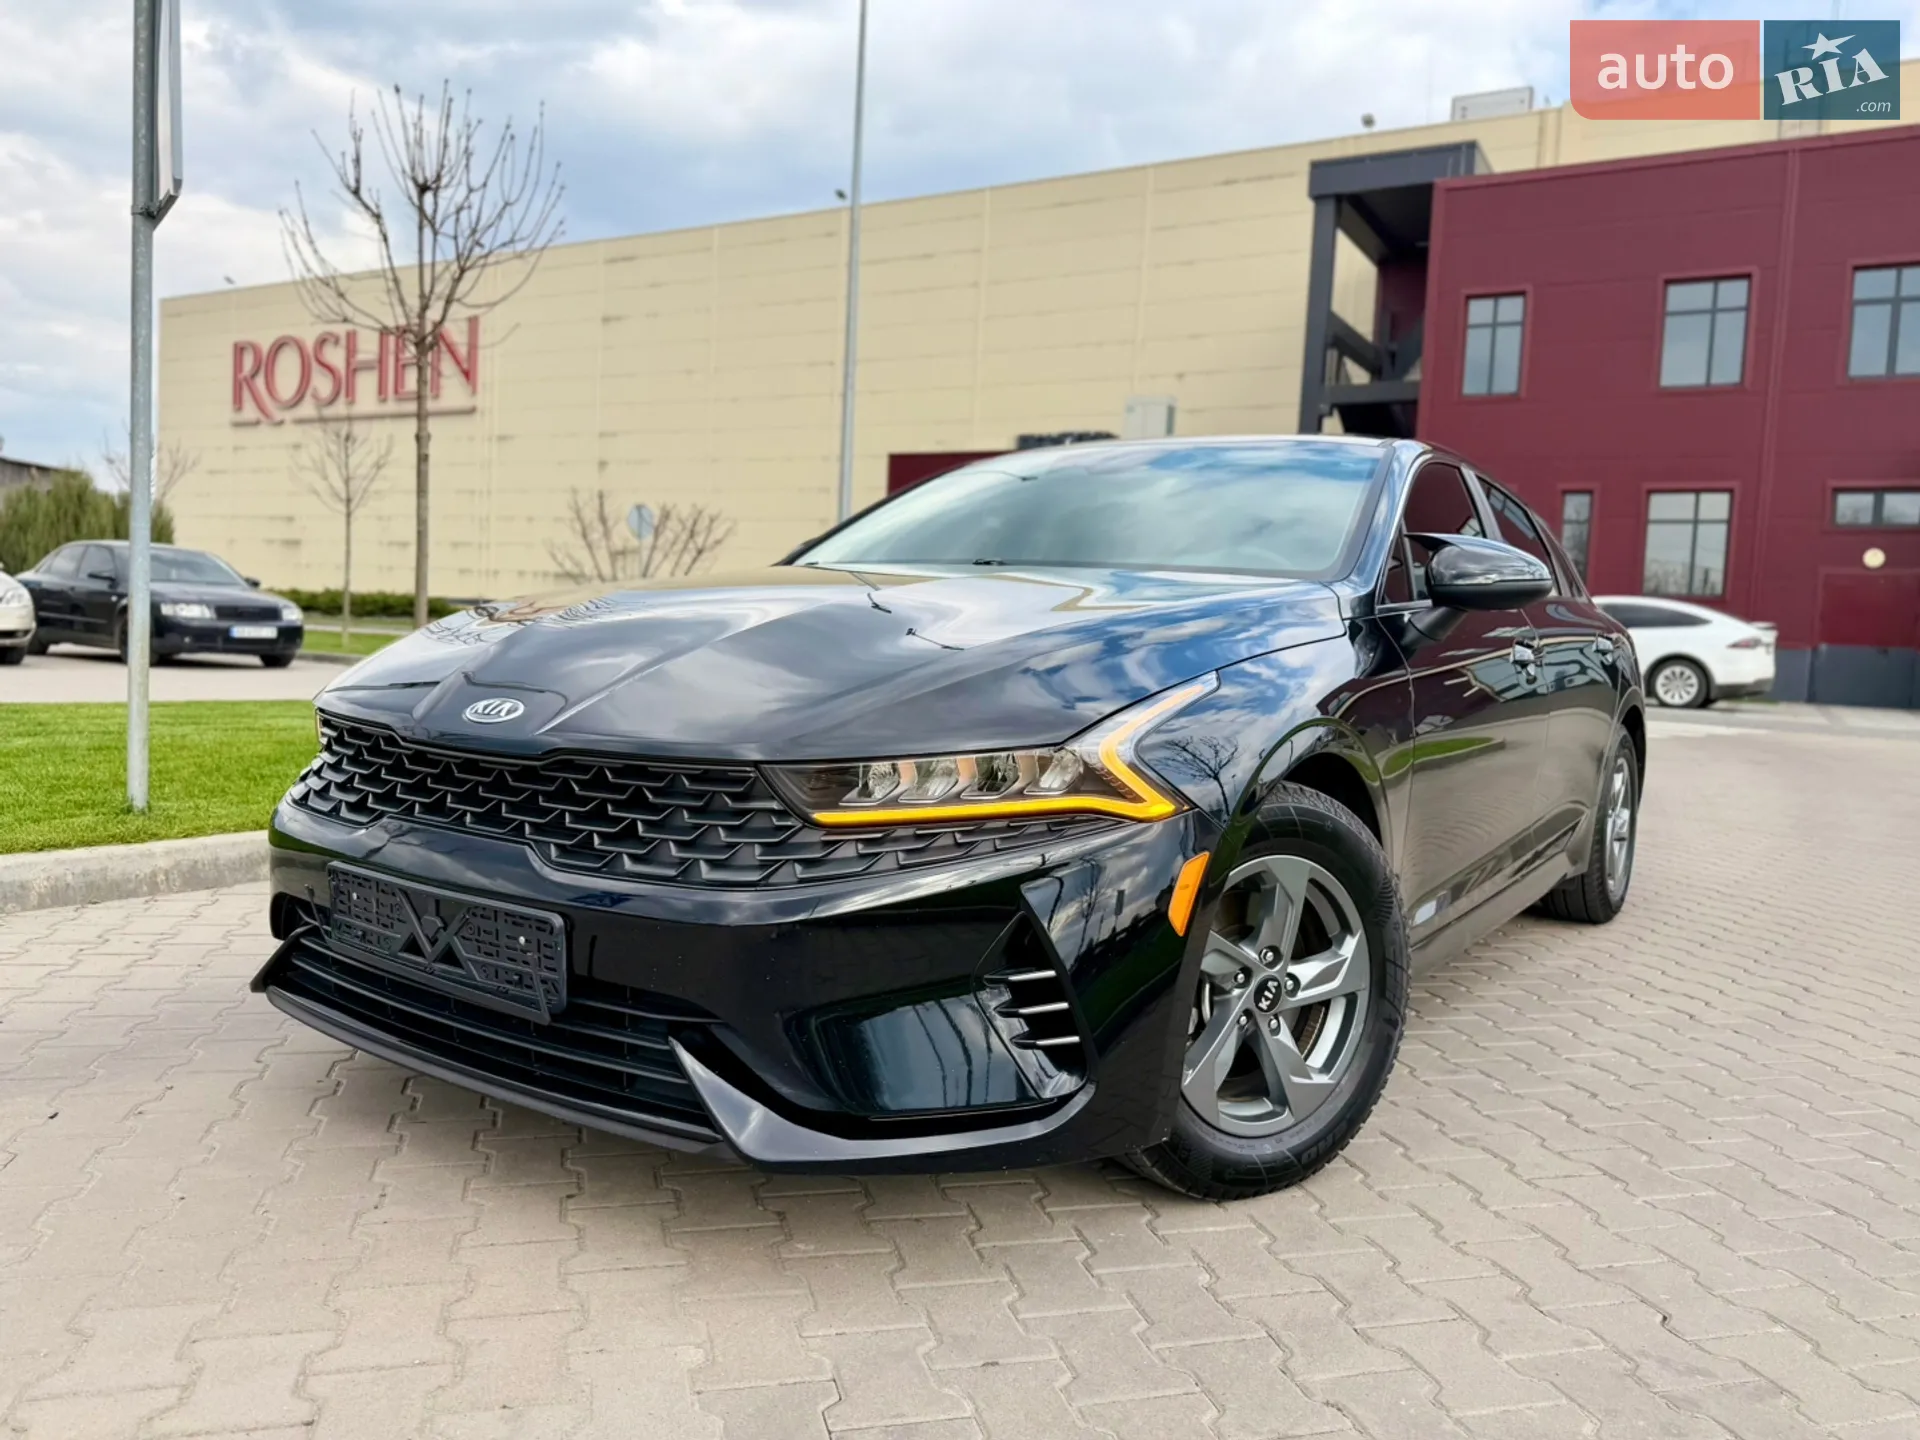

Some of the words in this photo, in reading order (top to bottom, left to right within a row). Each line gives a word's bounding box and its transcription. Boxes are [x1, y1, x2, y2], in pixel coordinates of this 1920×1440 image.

[232, 316, 479, 423] ROSHEN
[470, 698, 516, 718] KIA
[1257, 980, 1279, 1011] KIA
